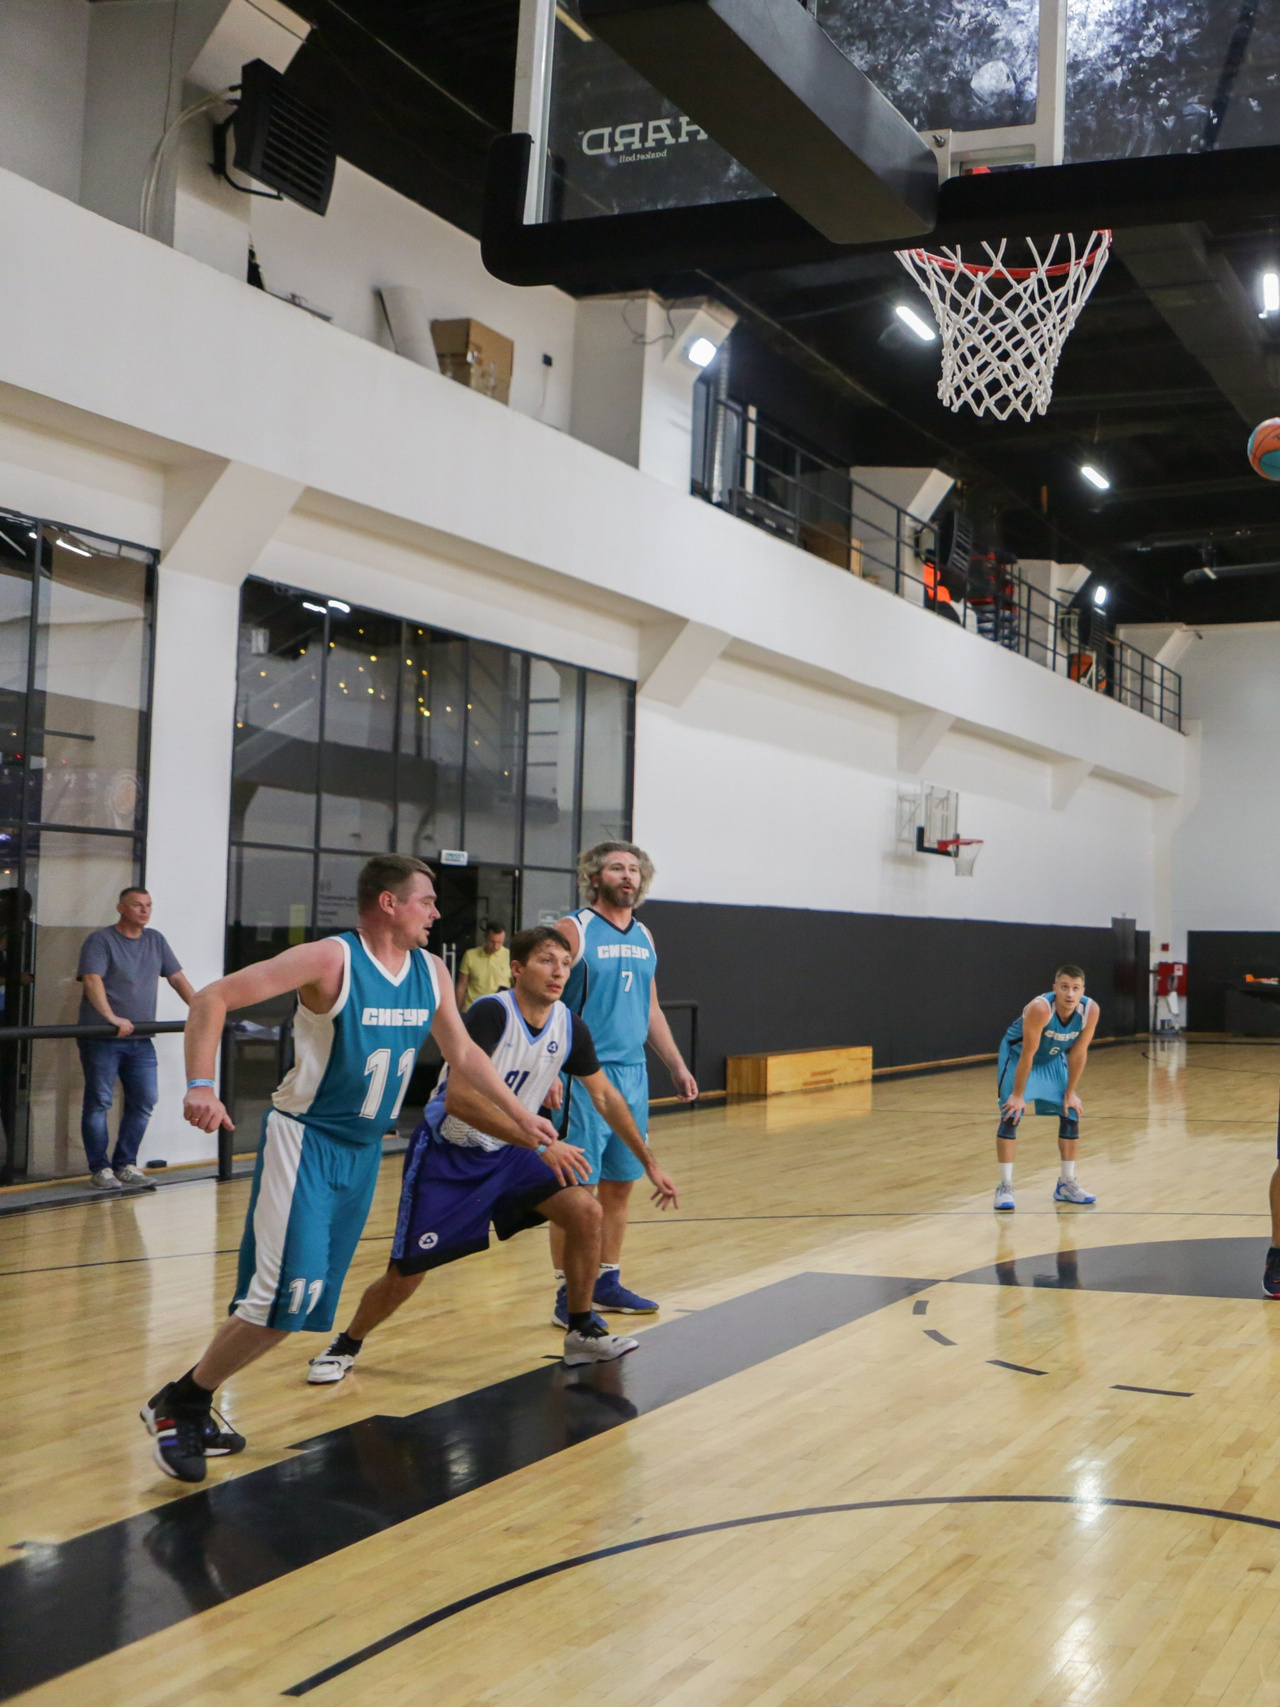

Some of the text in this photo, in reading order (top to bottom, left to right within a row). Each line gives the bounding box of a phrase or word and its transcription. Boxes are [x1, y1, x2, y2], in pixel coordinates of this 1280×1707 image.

[597, 943, 650, 960] СИБУР
[621, 970, 633, 992] 7
[361, 1007, 430, 1027] СИБУР
[359, 1048, 416, 1119] 11
[287, 1277, 324, 1315] 11
